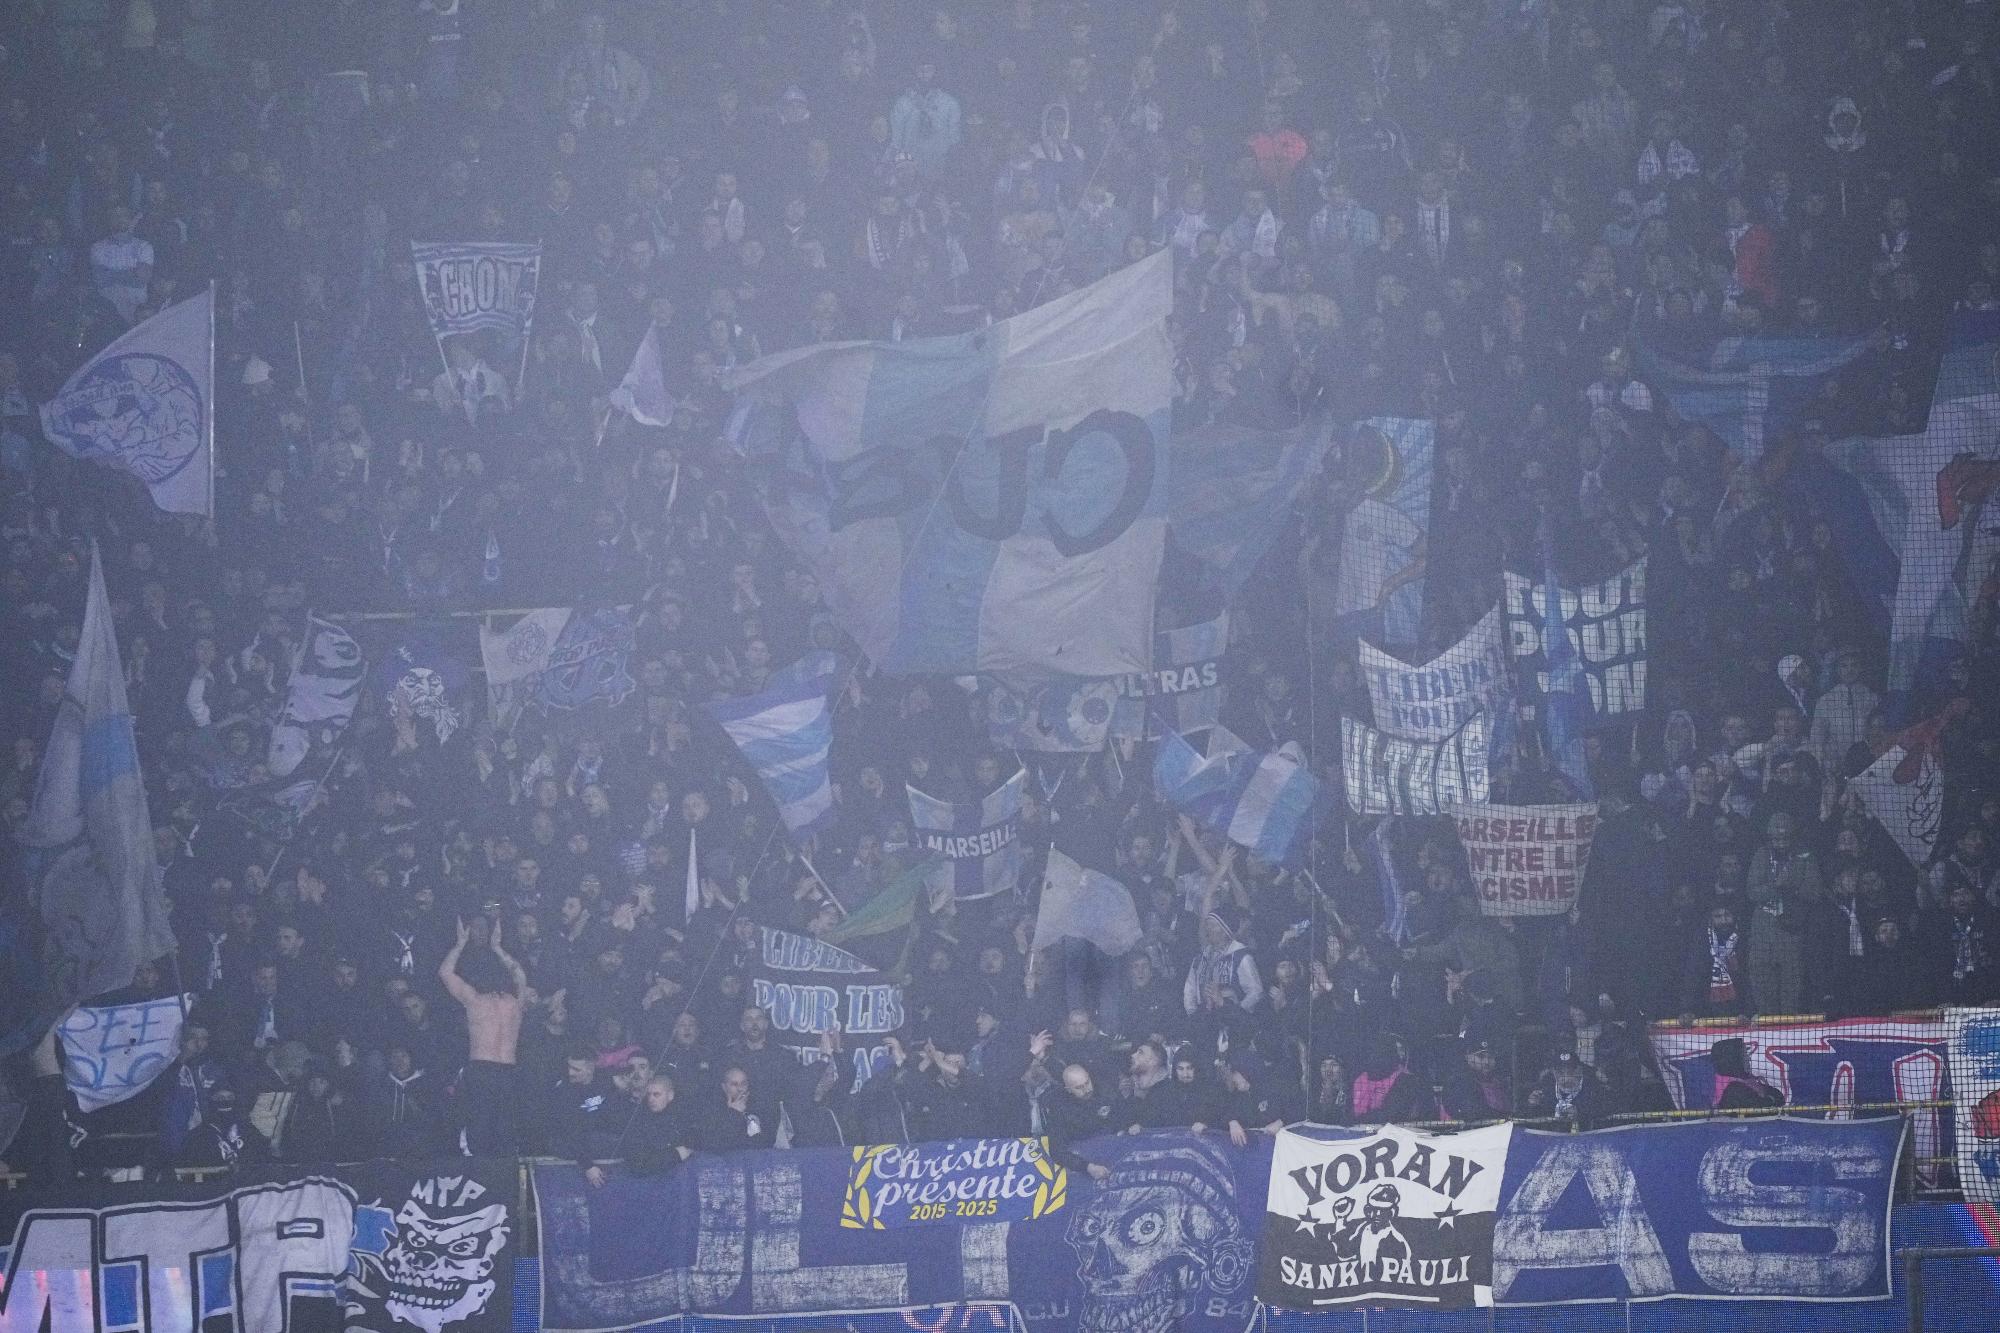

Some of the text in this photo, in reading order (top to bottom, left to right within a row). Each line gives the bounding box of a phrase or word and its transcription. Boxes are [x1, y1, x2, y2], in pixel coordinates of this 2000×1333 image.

[1502, 553, 1650, 624] TOUT
[752, 977, 906, 1035] POUR LES
[872, 1138, 1043, 1181] Christine
[1288, 1137, 1485, 1206] VORAN
[411, 1176, 487, 1208] MTP
[872, 1166, 1038, 1218] présente
[1280, 1254, 1472, 1290] SANKT PAULI
